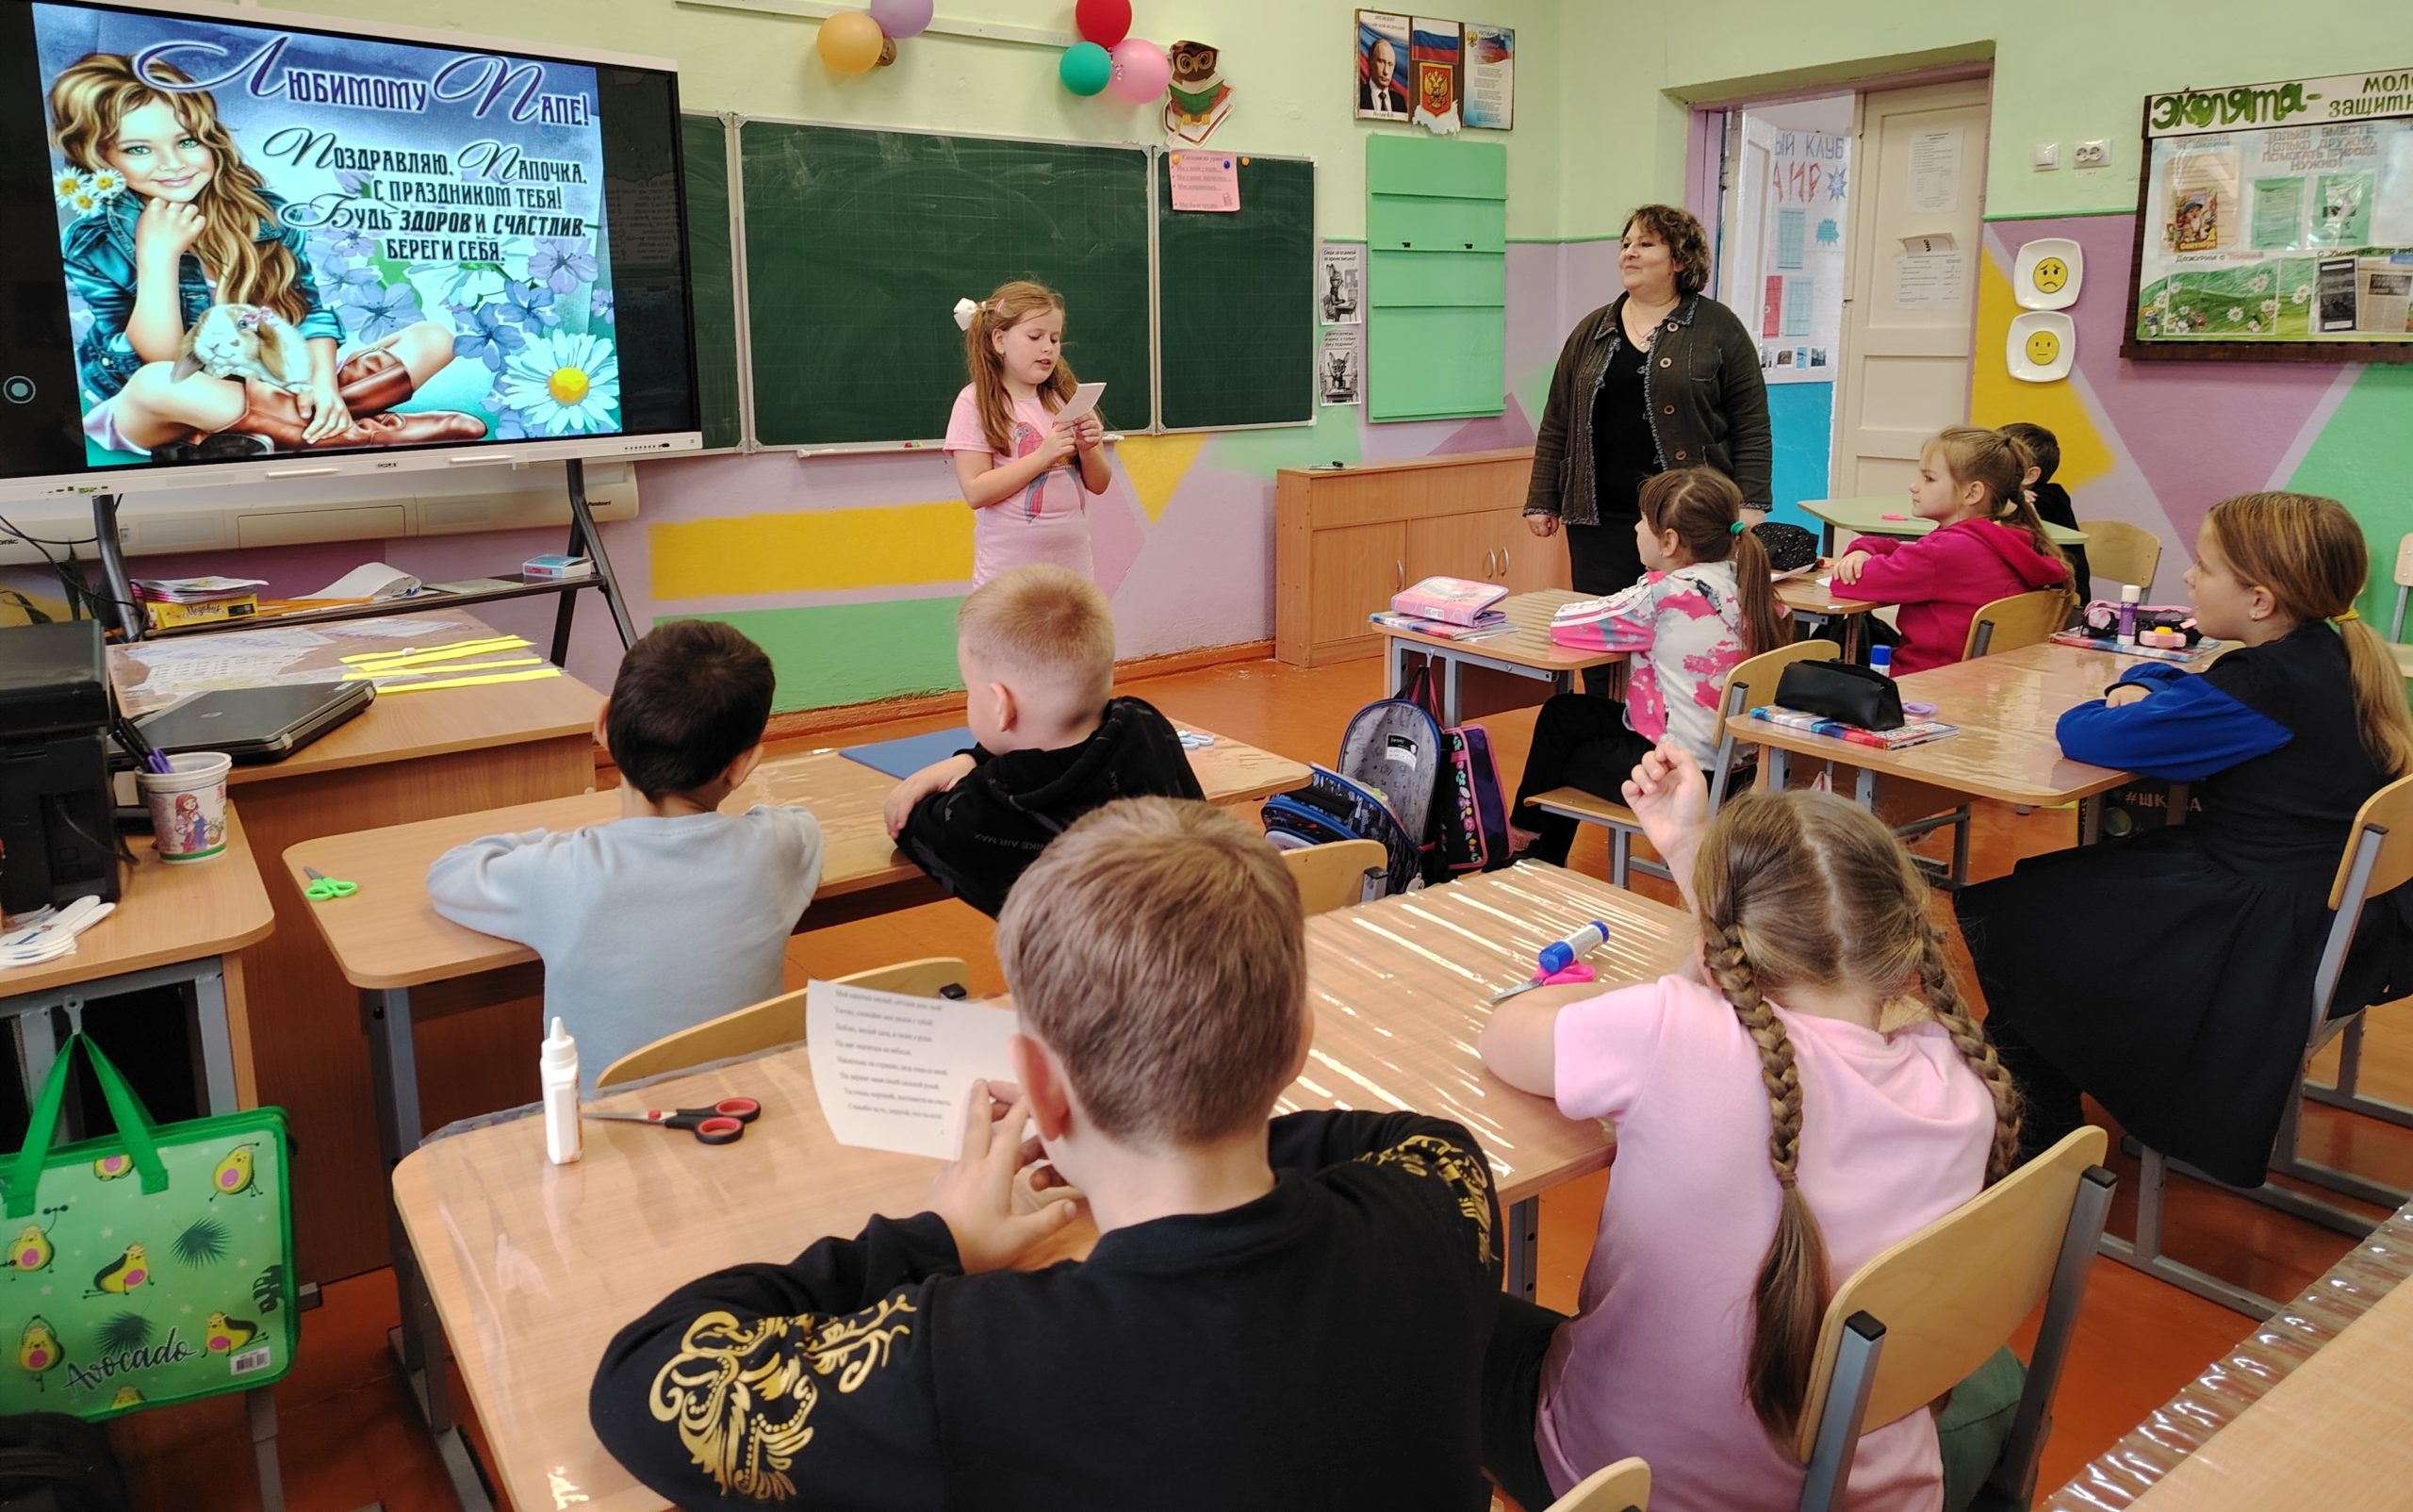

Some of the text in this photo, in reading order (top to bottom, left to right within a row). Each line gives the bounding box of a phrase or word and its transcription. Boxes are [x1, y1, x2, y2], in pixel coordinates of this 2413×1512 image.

[137, 36, 589, 126] ЛЮБИМОМУ ПАПЕ!
[2267, 129, 2310, 141] ТОЛЬКО
[1805, 134, 1845, 160] КЛУБ
[2262, 144, 2378, 163] ПОМОГАТЬ ПРИРОДЕ
[2267, 140, 2310, 152] ТОЛЬКО
[2290, 157, 2344, 172] НУЖНО!
[373, 180, 563, 209] С ПРАЗДНИКОМ ТЕБЯ!
[281, 192, 392, 230] БУДЬ
[400, 209, 473, 234] ЗДОРОВ
[475, 213, 486, 234] И
[386, 238, 505, 262] БЕРЕГИ СЕБЯ.
[2126, 792, 2203, 813] #ШКА
[974, 832, 996, 845] MAX
[999, 839, 1019, 848] AIR
[62, 1327, 197, 1395] Avocado
